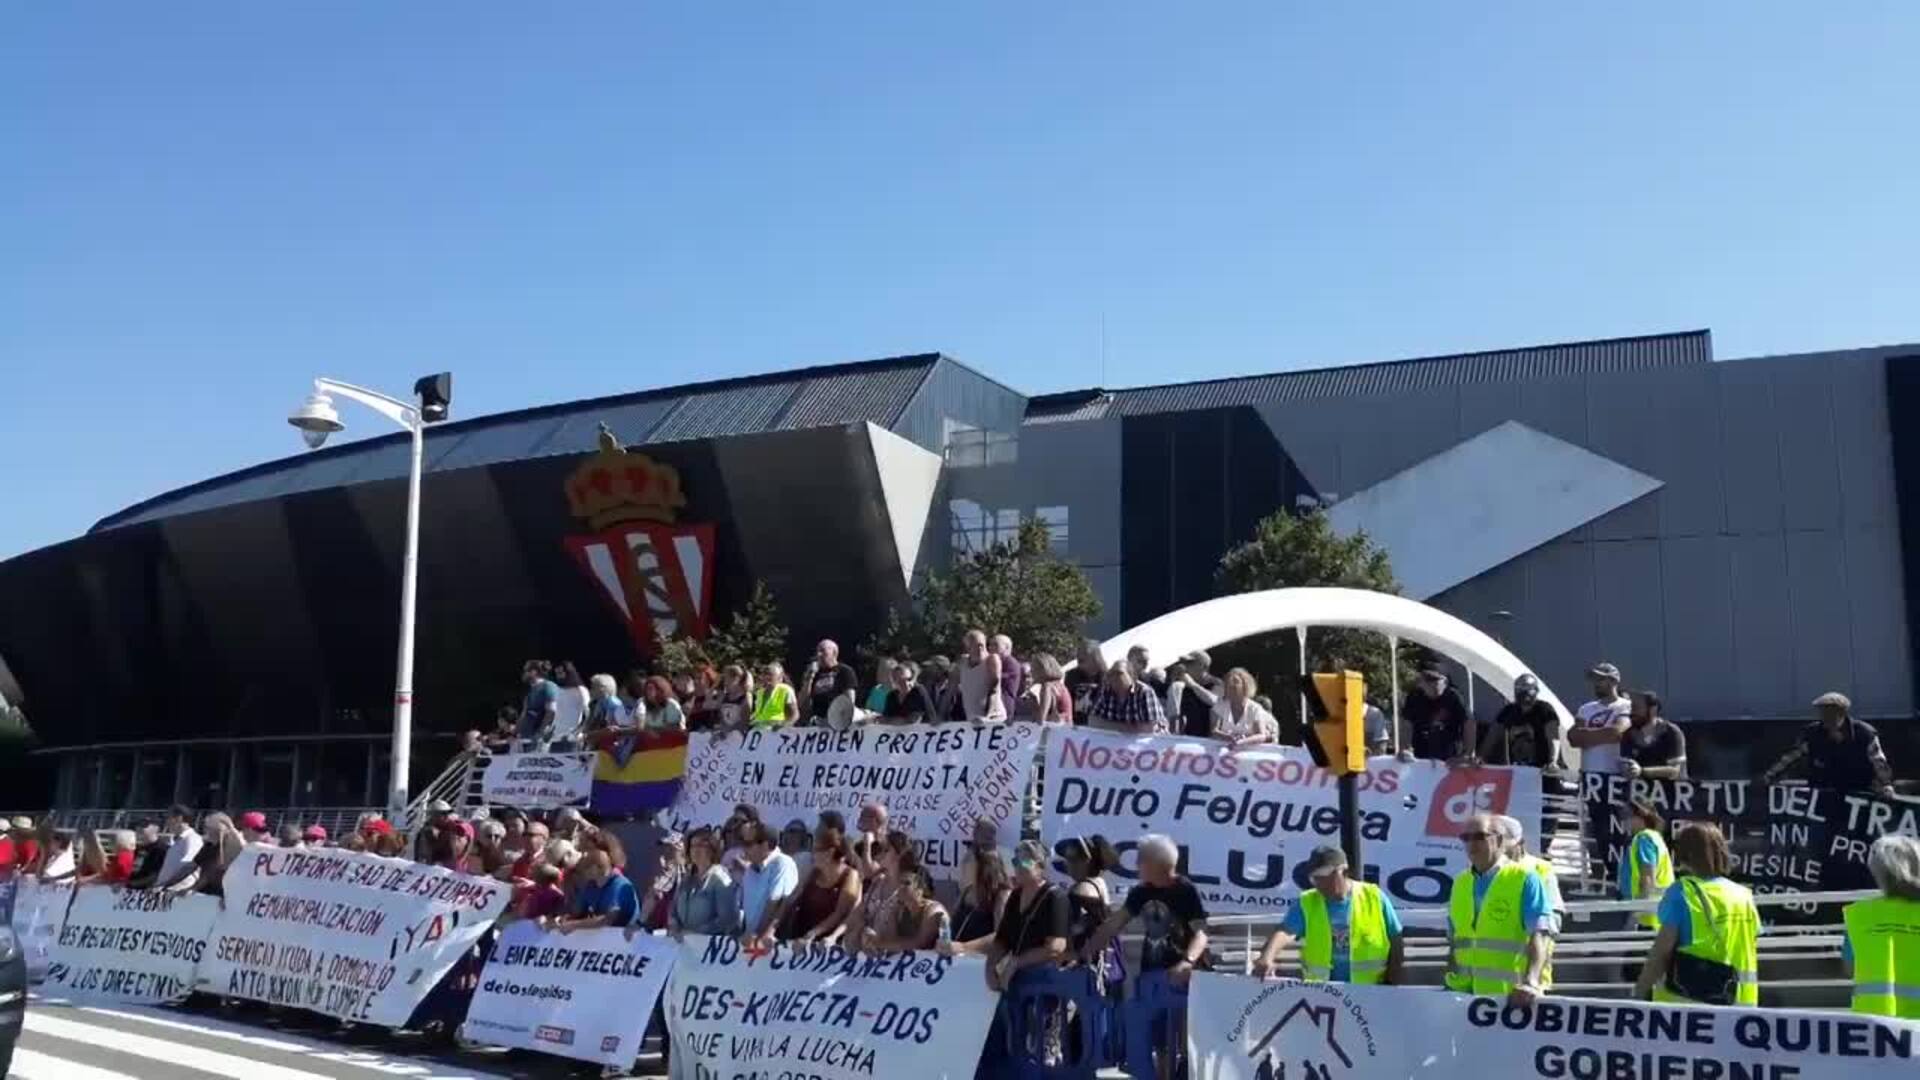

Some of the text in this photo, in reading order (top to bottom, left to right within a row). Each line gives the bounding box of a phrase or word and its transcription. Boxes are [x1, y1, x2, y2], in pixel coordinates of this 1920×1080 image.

[777, 730, 866, 754] TAMBIEN
[875, 725, 1005, 755] PROTESTE
[1058, 738, 1240, 779] Nosotros
[740, 762, 970, 791] EN EL RECONQUISTA
[1055, 776, 1393, 843] Duro Felguea
[1768, 784, 1827, 822] DEL
[348, 863, 386, 886] SAD
[381, 868, 413, 892] DE
[405, 873, 497, 910] ASTURIAS
[701, 934, 741, 966] NO
[326, 953, 397, 992] DOMICILIO
[1466, 997, 1913, 1059] GOBIERNE QUIEN
[796, 1038, 876, 1076] LUCHA
